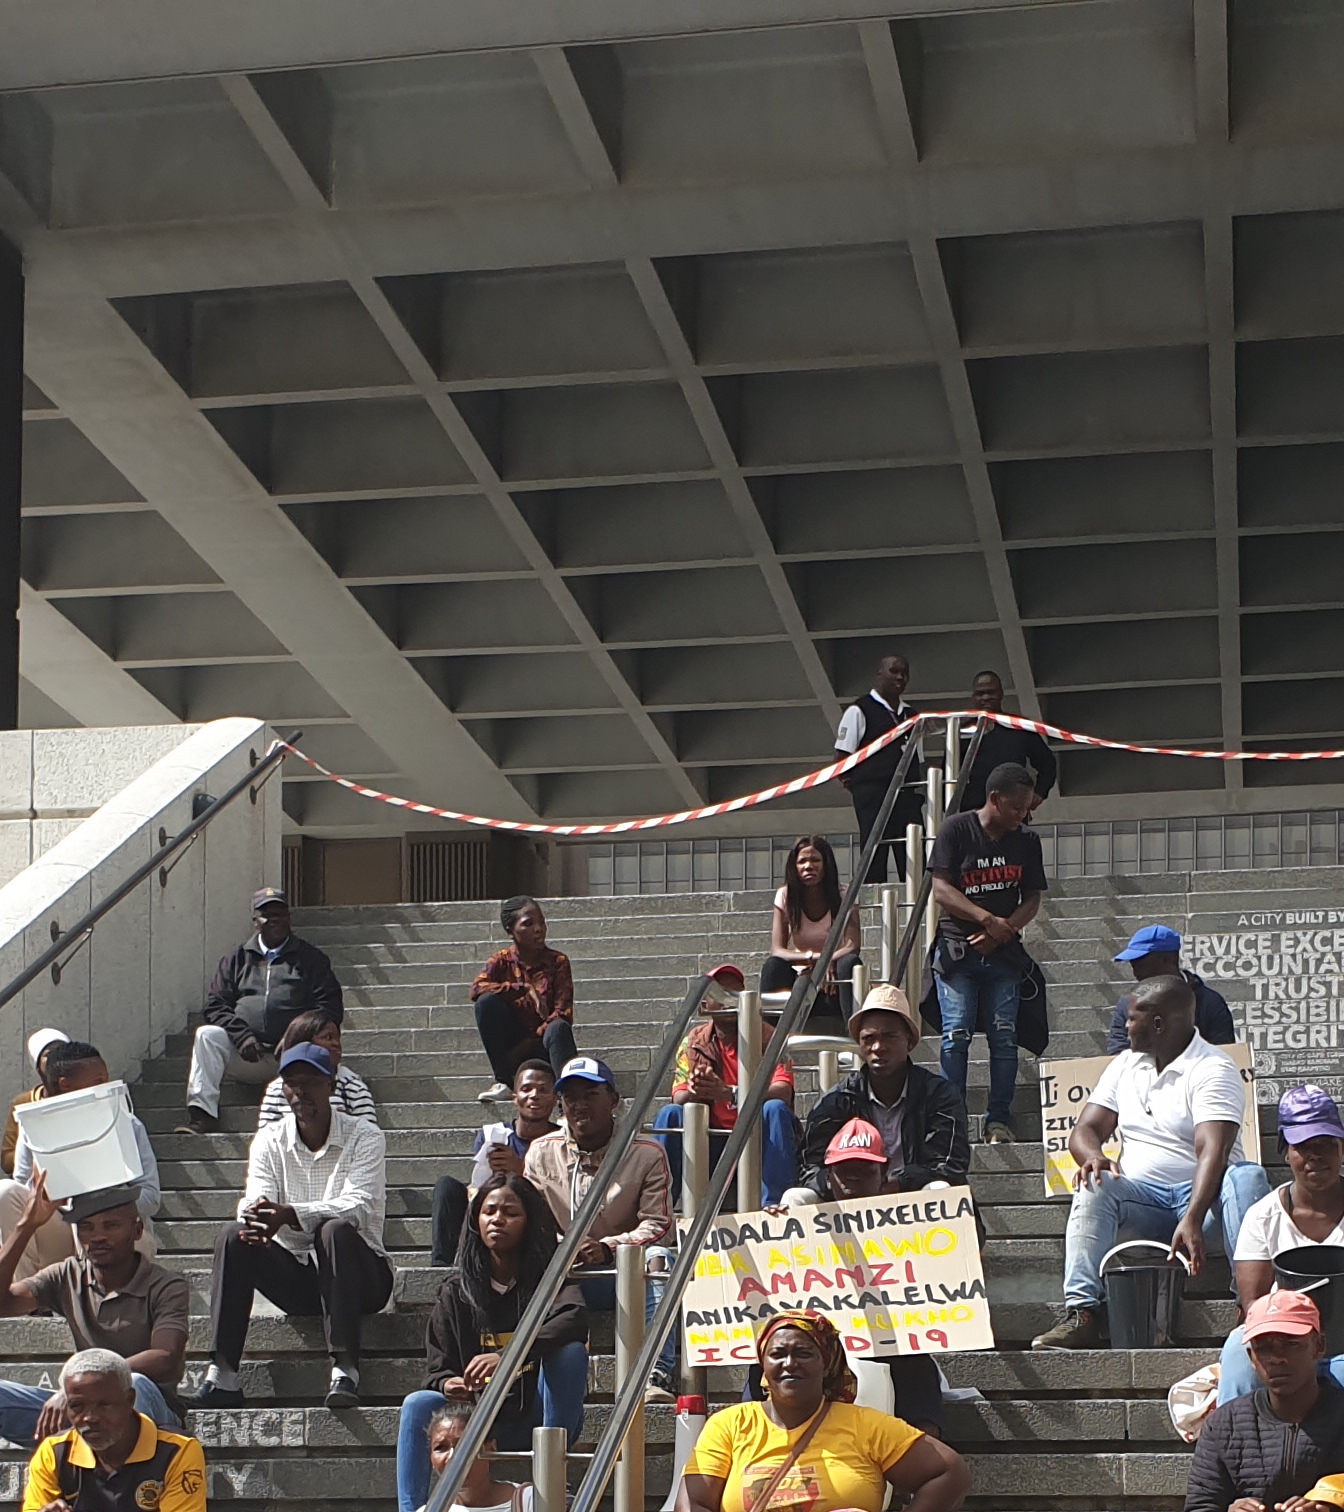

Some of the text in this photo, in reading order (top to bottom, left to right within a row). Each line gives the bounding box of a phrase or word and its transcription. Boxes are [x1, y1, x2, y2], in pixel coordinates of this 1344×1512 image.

[992, 856, 1005, 866] AN
[962, 865, 1023, 886] ACTIVIST
[965, 885, 980, 895] AND
[981, 882, 1004, 892] PROUD
[1238, 914, 1249, 926] A
[1251, 913, 1282, 925] CITY
[1286, 911, 1324, 925] BUILT
[1182, 933, 1272, 958] ERVICE
[1249, 974, 1344, 1000] TRUST
[839, 1132, 871, 1149] RAW
[813, 1198, 975, 1235] SINIXELELA
[768, 1227, 958, 1269] ASINAWO
[738, 1260, 917, 1302] AMANZI
[38, 1371, 54, 1388] A
